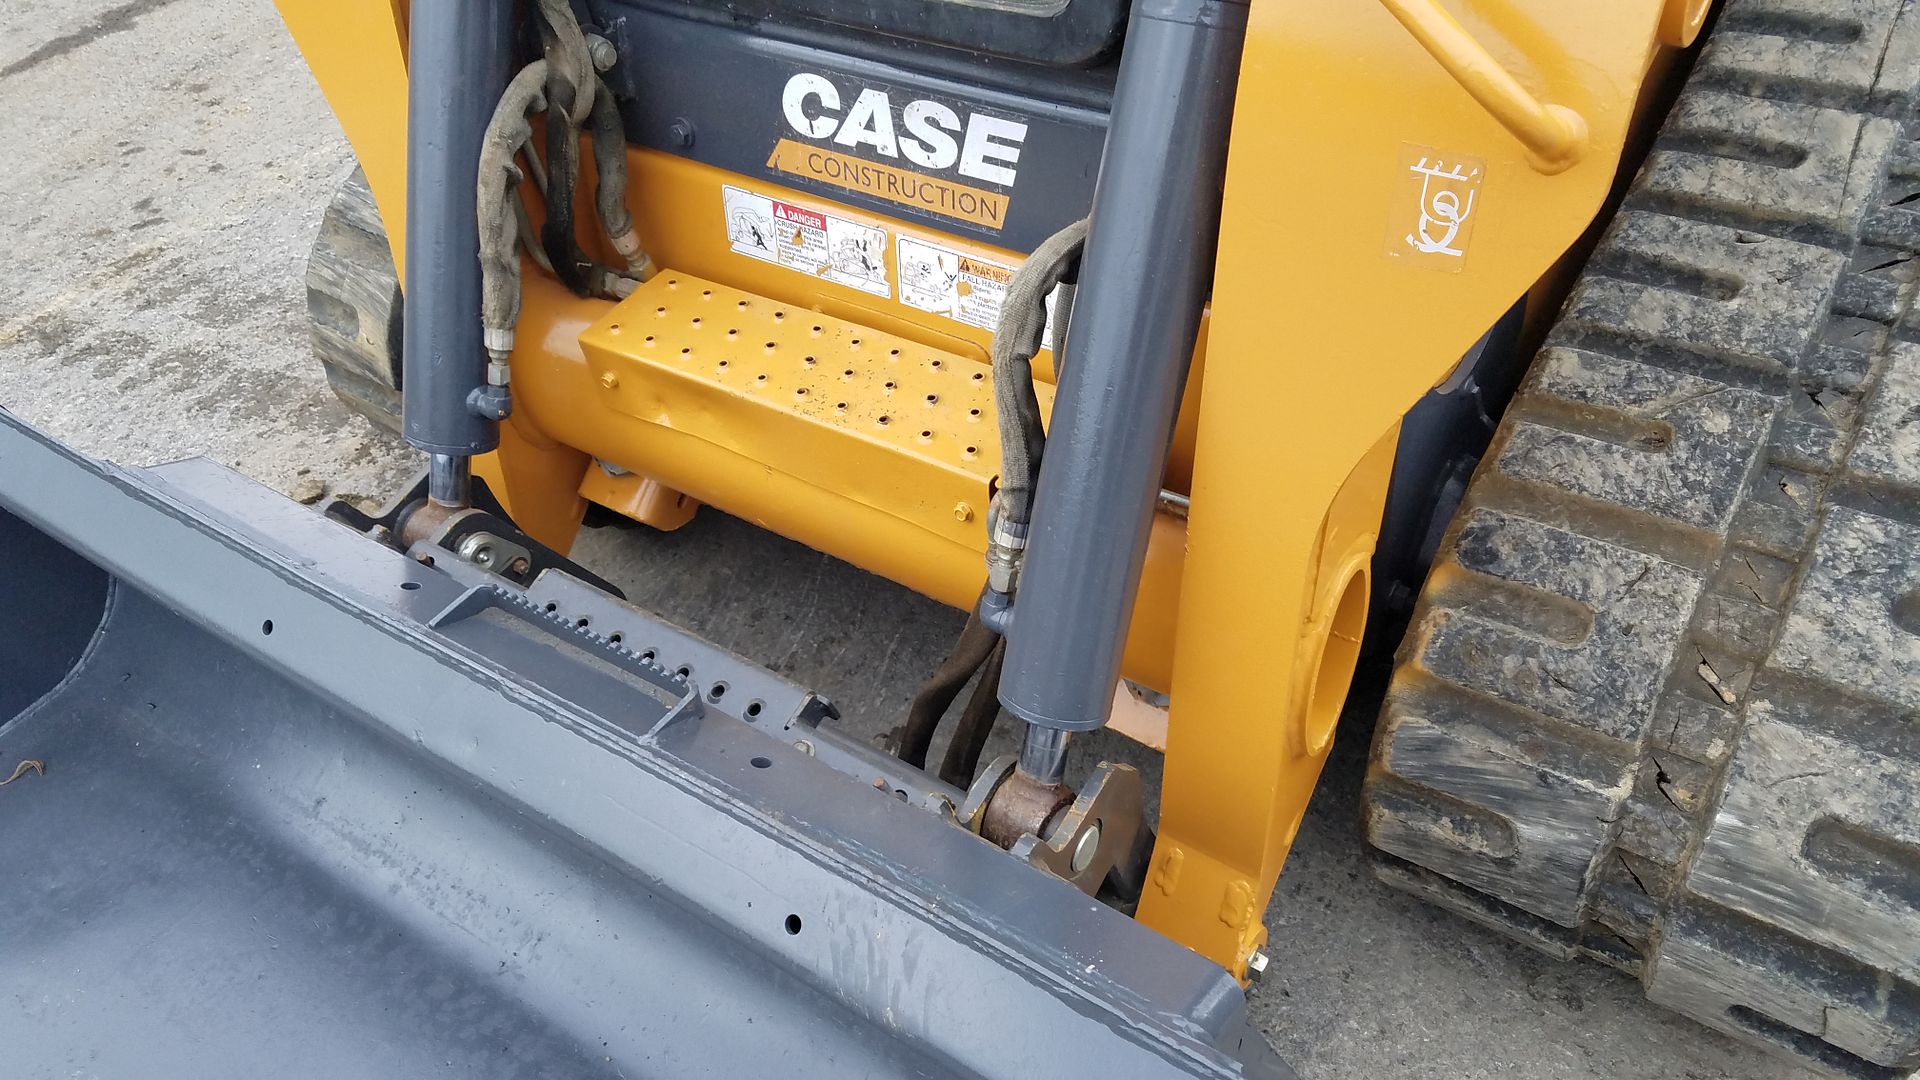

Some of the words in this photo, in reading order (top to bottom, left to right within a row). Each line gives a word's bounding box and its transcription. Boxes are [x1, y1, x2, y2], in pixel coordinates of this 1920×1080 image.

[782, 73, 1028, 187] CASE
[807, 152, 997, 221] CONSTRUCTION
[777, 219, 798, 230] CRUSH
[787, 210, 822, 229] DANGER
[962, 273, 980, 285] FALL
[981, 279, 1007, 291] HAZAR
[971, 264, 1011, 282] WARNING
